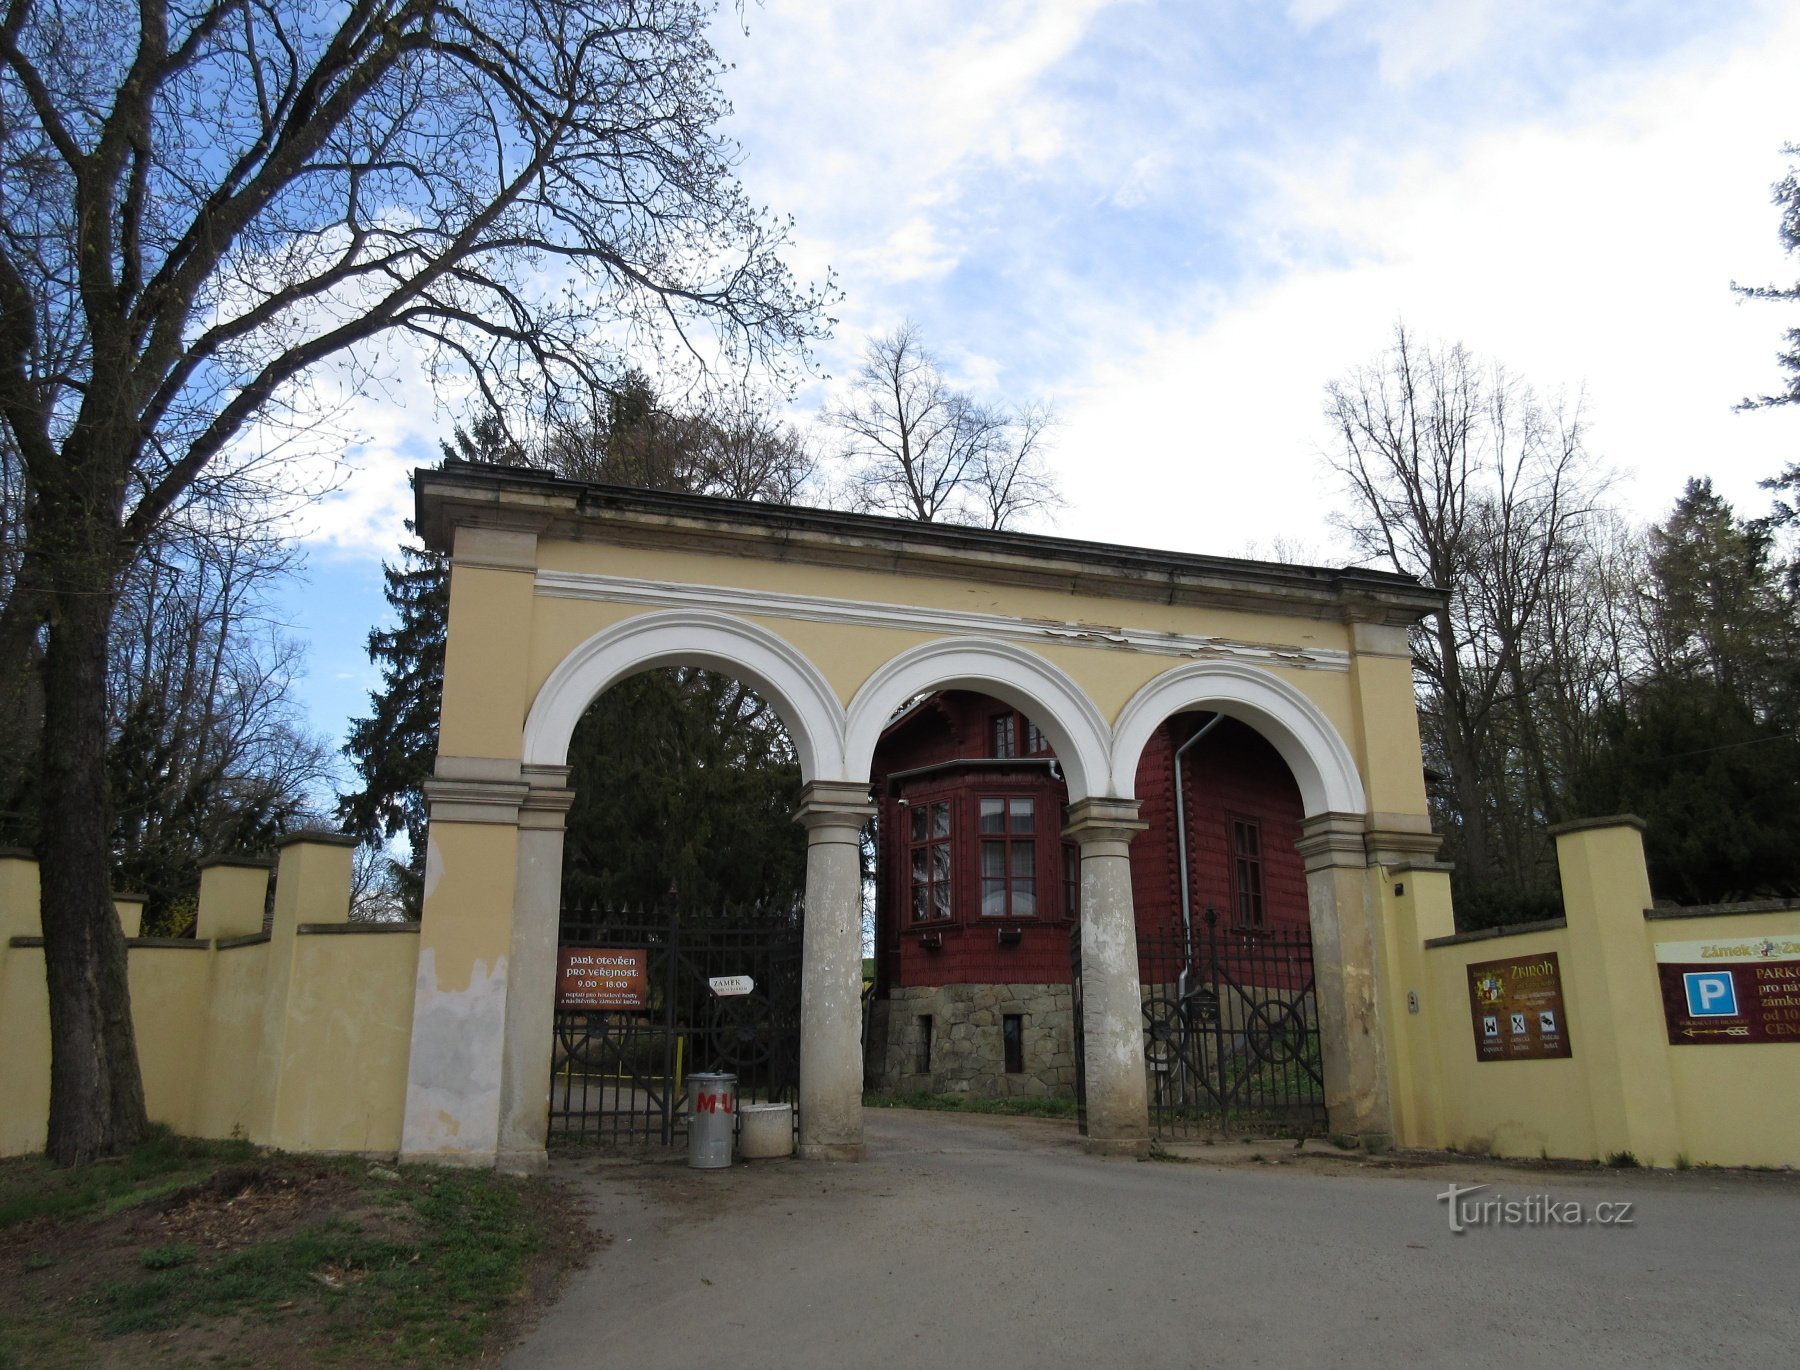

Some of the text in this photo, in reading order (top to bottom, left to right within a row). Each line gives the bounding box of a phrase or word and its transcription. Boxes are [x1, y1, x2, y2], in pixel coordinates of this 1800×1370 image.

[577, 980, 597, 988] 9.00
[1698, 979, 1726, 1009] P
[1758, 985, 1779, 996] pro
[1763, 1008, 1779, 1021] od
